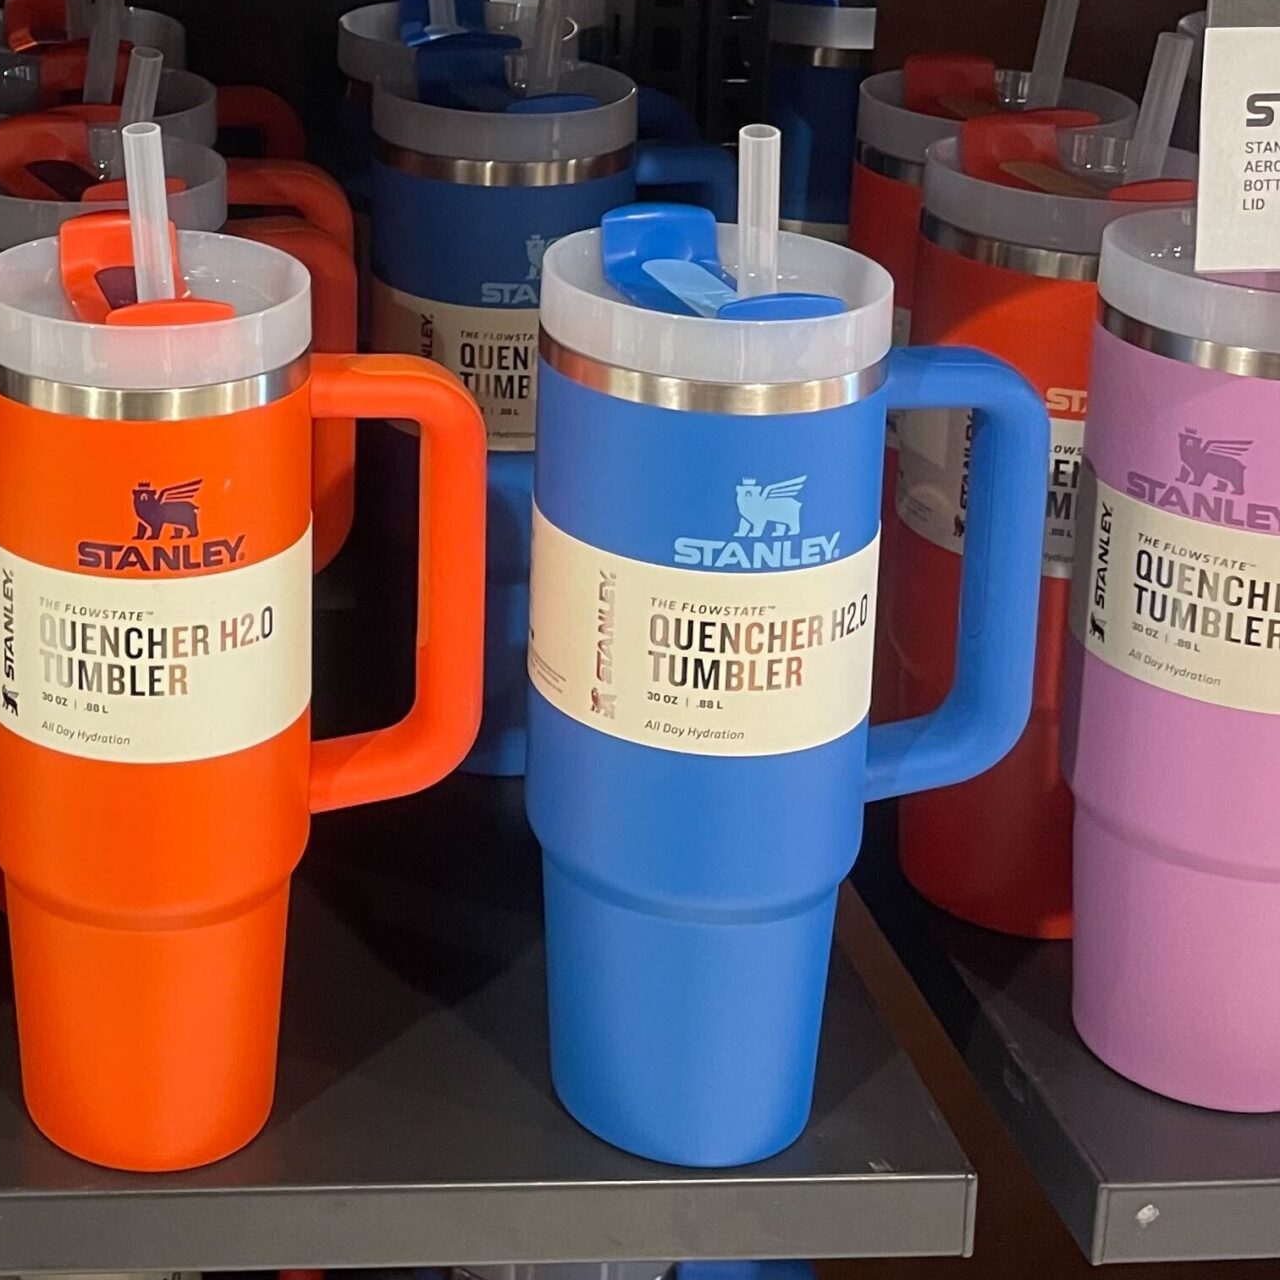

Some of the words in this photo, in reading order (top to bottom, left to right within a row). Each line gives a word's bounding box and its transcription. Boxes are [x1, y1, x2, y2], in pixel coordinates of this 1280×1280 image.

[1242, 198, 1265, 210] LID
[460, 342, 535, 370] QUEN
[459, 371, 531, 400] TUMB
[1137, 532, 1159, 549] THE
[39, 596, 61, 611] THE
[650, 597, 677, 610] THE
[39, 613, 210, 659] QUENCHER
[220, 605, 274, 653] H2.0
[649, 614, 824, 655] QUENCHER
[831, 593, 868, 642] H2.0
[1145, 627, 1159, 639] OZ
[1194, 643, 1200, 652] L
[39, 649, 188, 697] TUMBLER
[648, 650, 803, 692] TUMBLER
[1128, 649, 1142, 661] All
[1143, 654, 1163, 670] Day
[1165, 663, 1221, 686] Hydration
[55, 695, 68, 706] OZ
[102, 705, 109, 714] L
[663, 694, 678, 705] OZ
[716, 700, 723, 710] L
[41, 720, 54, 732] All
[56, 724, 75, 740] Day
[77, 729, 130, 745] Hydration
[644, 720, 660, 731] All
[663, 723, 685, 738] Day
[687, 727, 745, 740] Hydration
